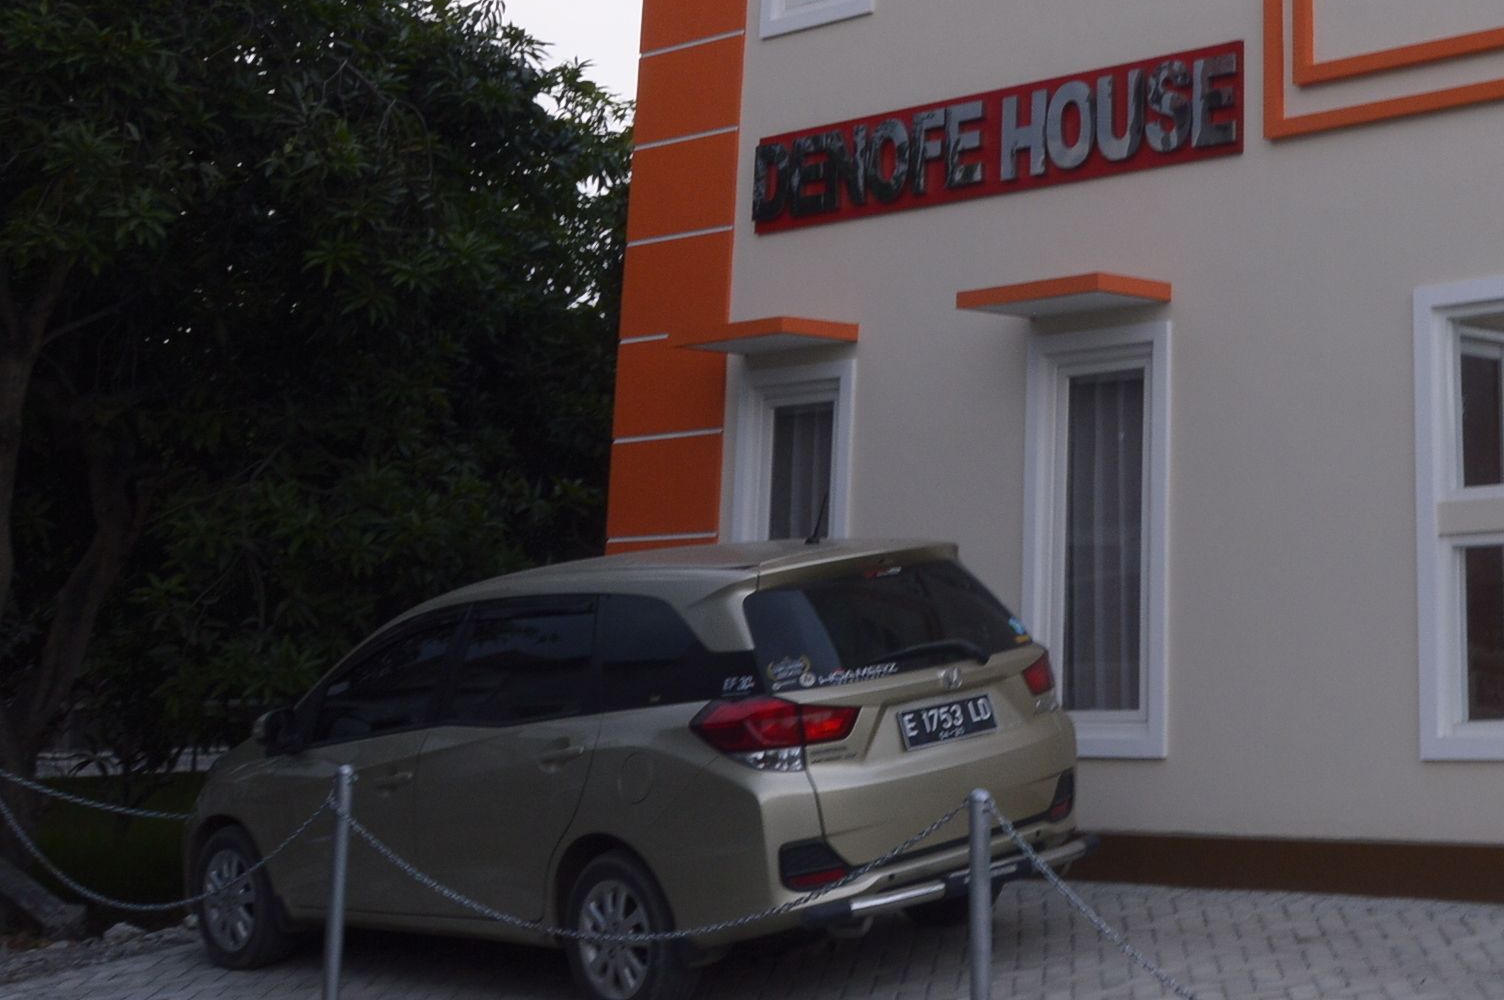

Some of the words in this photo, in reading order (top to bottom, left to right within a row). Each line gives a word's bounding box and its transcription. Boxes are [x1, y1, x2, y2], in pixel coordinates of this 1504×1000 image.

[752, 100, 986, 223] DENOFE
[1000, 53, 1237, 182] HOUSE
[903, 713, 918, 737] E
[921, 704, 963, 733] 1753
